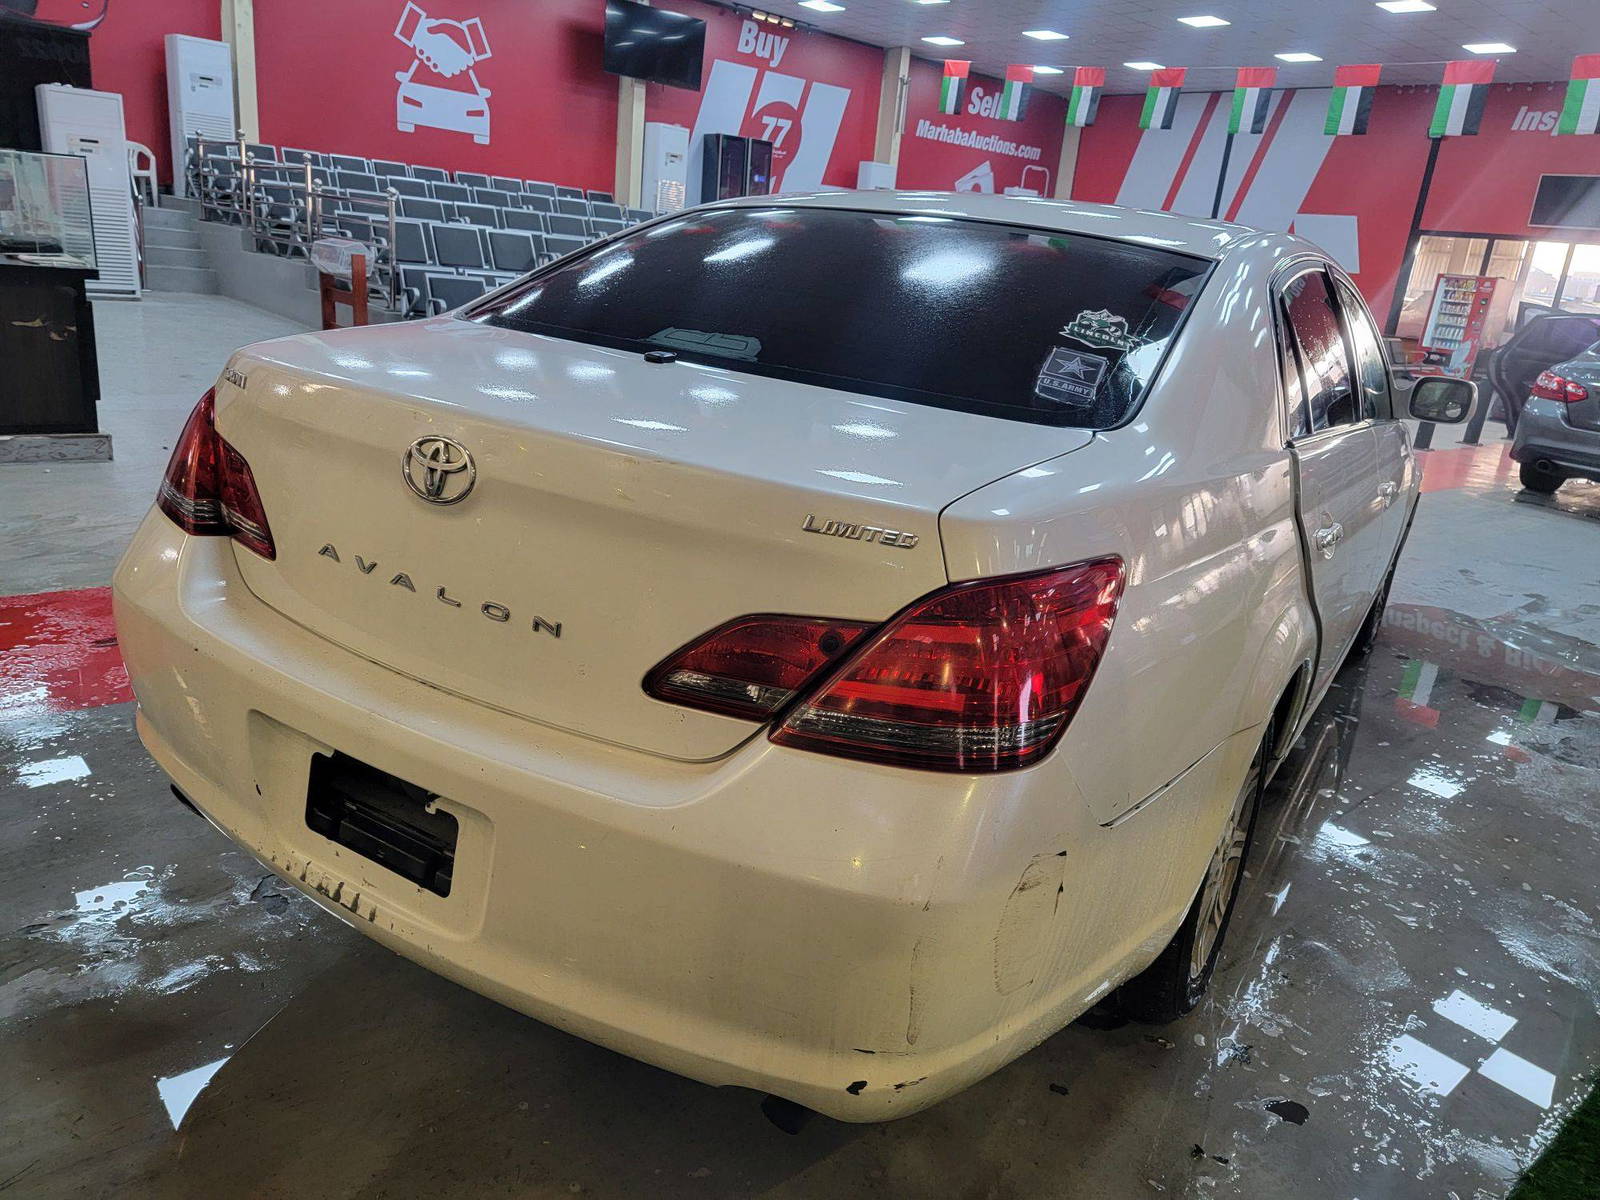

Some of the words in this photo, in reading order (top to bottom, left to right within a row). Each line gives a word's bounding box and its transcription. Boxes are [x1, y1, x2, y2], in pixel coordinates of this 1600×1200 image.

[737, 19, 790, 68] Buy
[761, 115, 793, 149] 77
[916, 119, 1042, 161] MarhabaAuctions.com
[1511, 105, 1561, 137] Ins
[802, 513, 920, 549] LIMITED
[318, 543, 562, 638] AVALON
